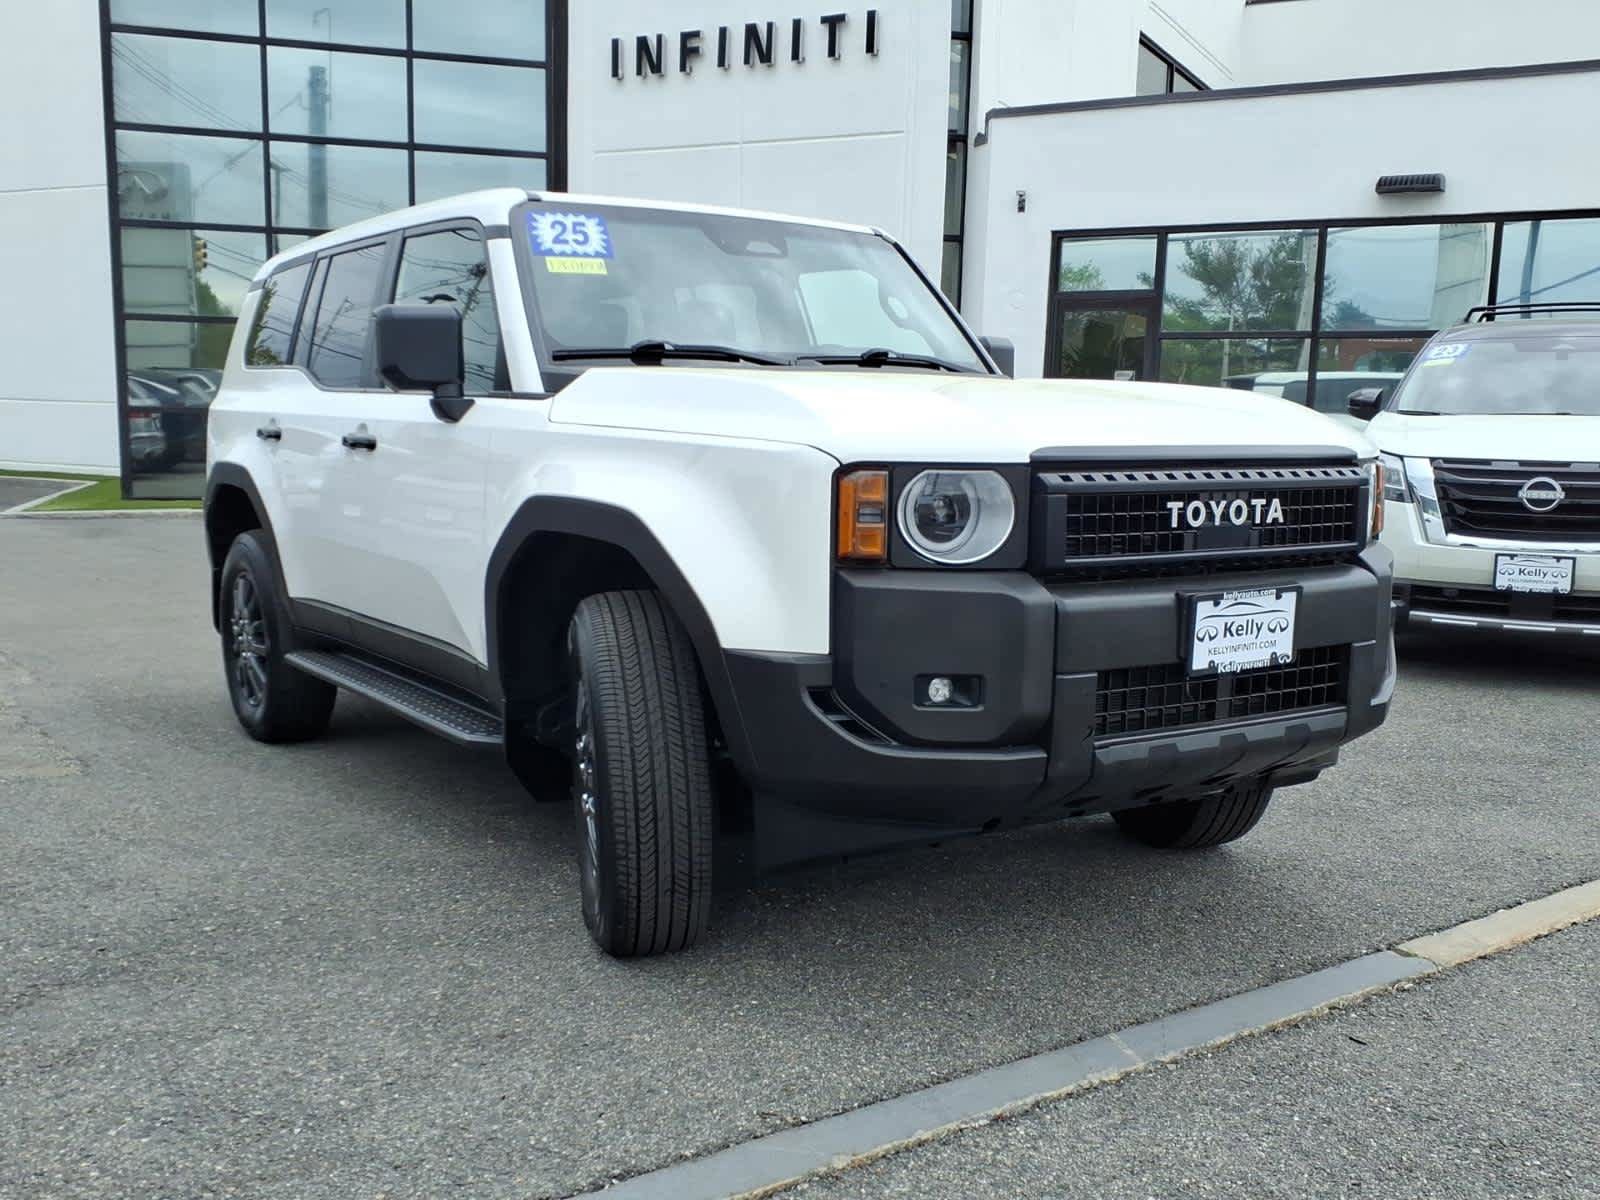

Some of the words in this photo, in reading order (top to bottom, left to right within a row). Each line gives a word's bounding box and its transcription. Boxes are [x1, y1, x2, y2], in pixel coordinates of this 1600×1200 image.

[611, 10, 878, 79] INFINITI
[550, 220, 590, 245] 25
[1166, 498, 1284, 528] TOYOTA
[1519, 568, 1548, 578] Kelly
[1223, 619, 1264, 639] Kelly
[1208, 640, 1277, 657] KELLYINFINITI.COM
